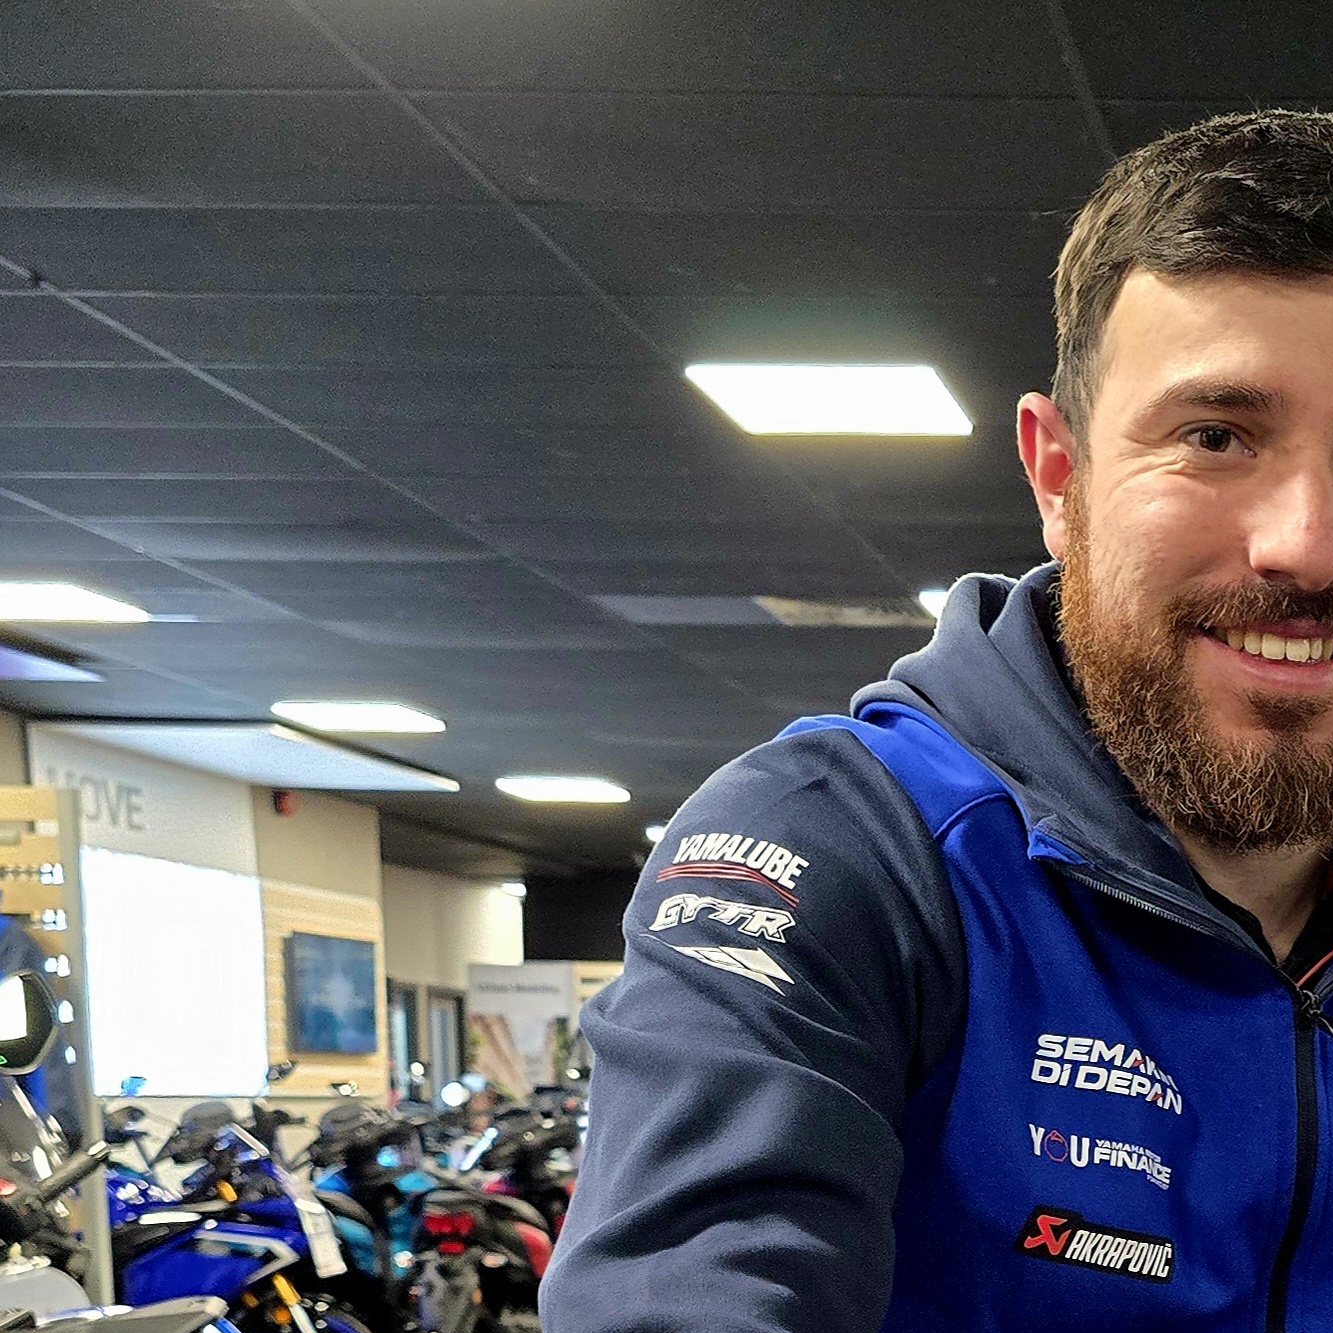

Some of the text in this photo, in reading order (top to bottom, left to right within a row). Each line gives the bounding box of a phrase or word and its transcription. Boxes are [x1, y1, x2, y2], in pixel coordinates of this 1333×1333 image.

[672, 833, 809, 890] YAMALUBE
[649, 893, 796, 943] GYTR
[1075, 1065, 1183, 1115] DEPAN
[1029, 1123, 1090, 1168] YOU
[1093, 1146, 1172, 1184] FINANCE
